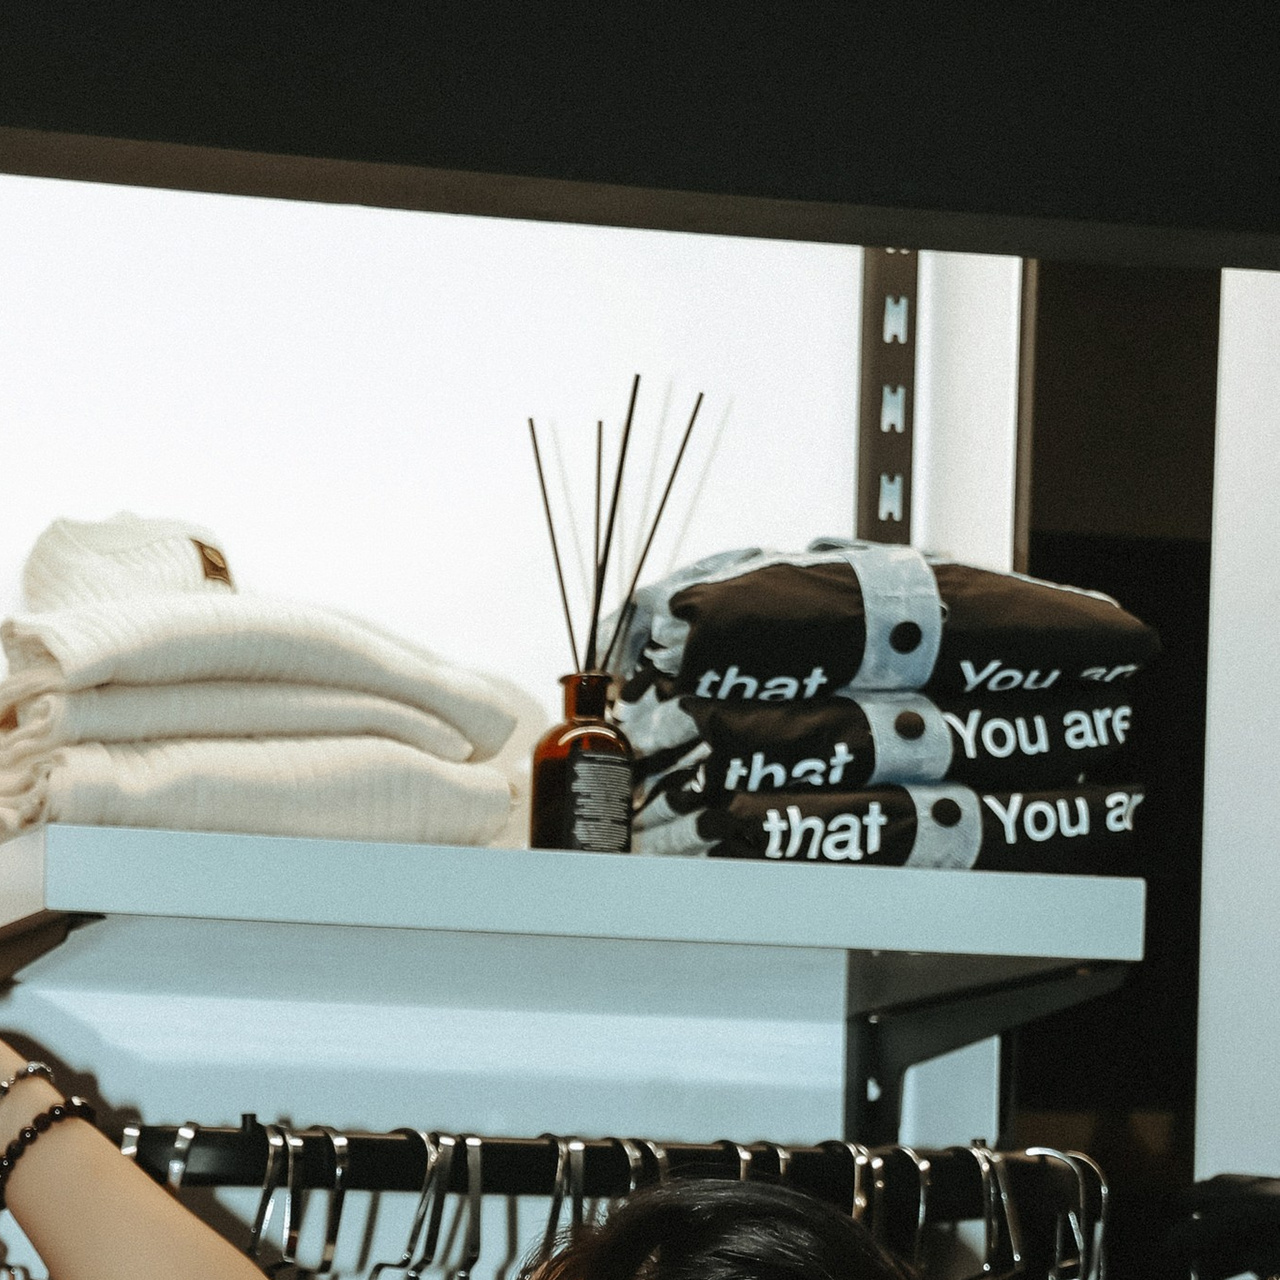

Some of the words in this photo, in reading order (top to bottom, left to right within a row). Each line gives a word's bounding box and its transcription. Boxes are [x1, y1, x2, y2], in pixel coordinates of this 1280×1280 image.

[695, 665, 829, 700] that
[959, 660, 1061, 692] You
[942, 708, 1050, 760] You
[724, 742, 855, 792] that
[762, 801, 889, 861] that
[982, 792, 1091, 845] You
